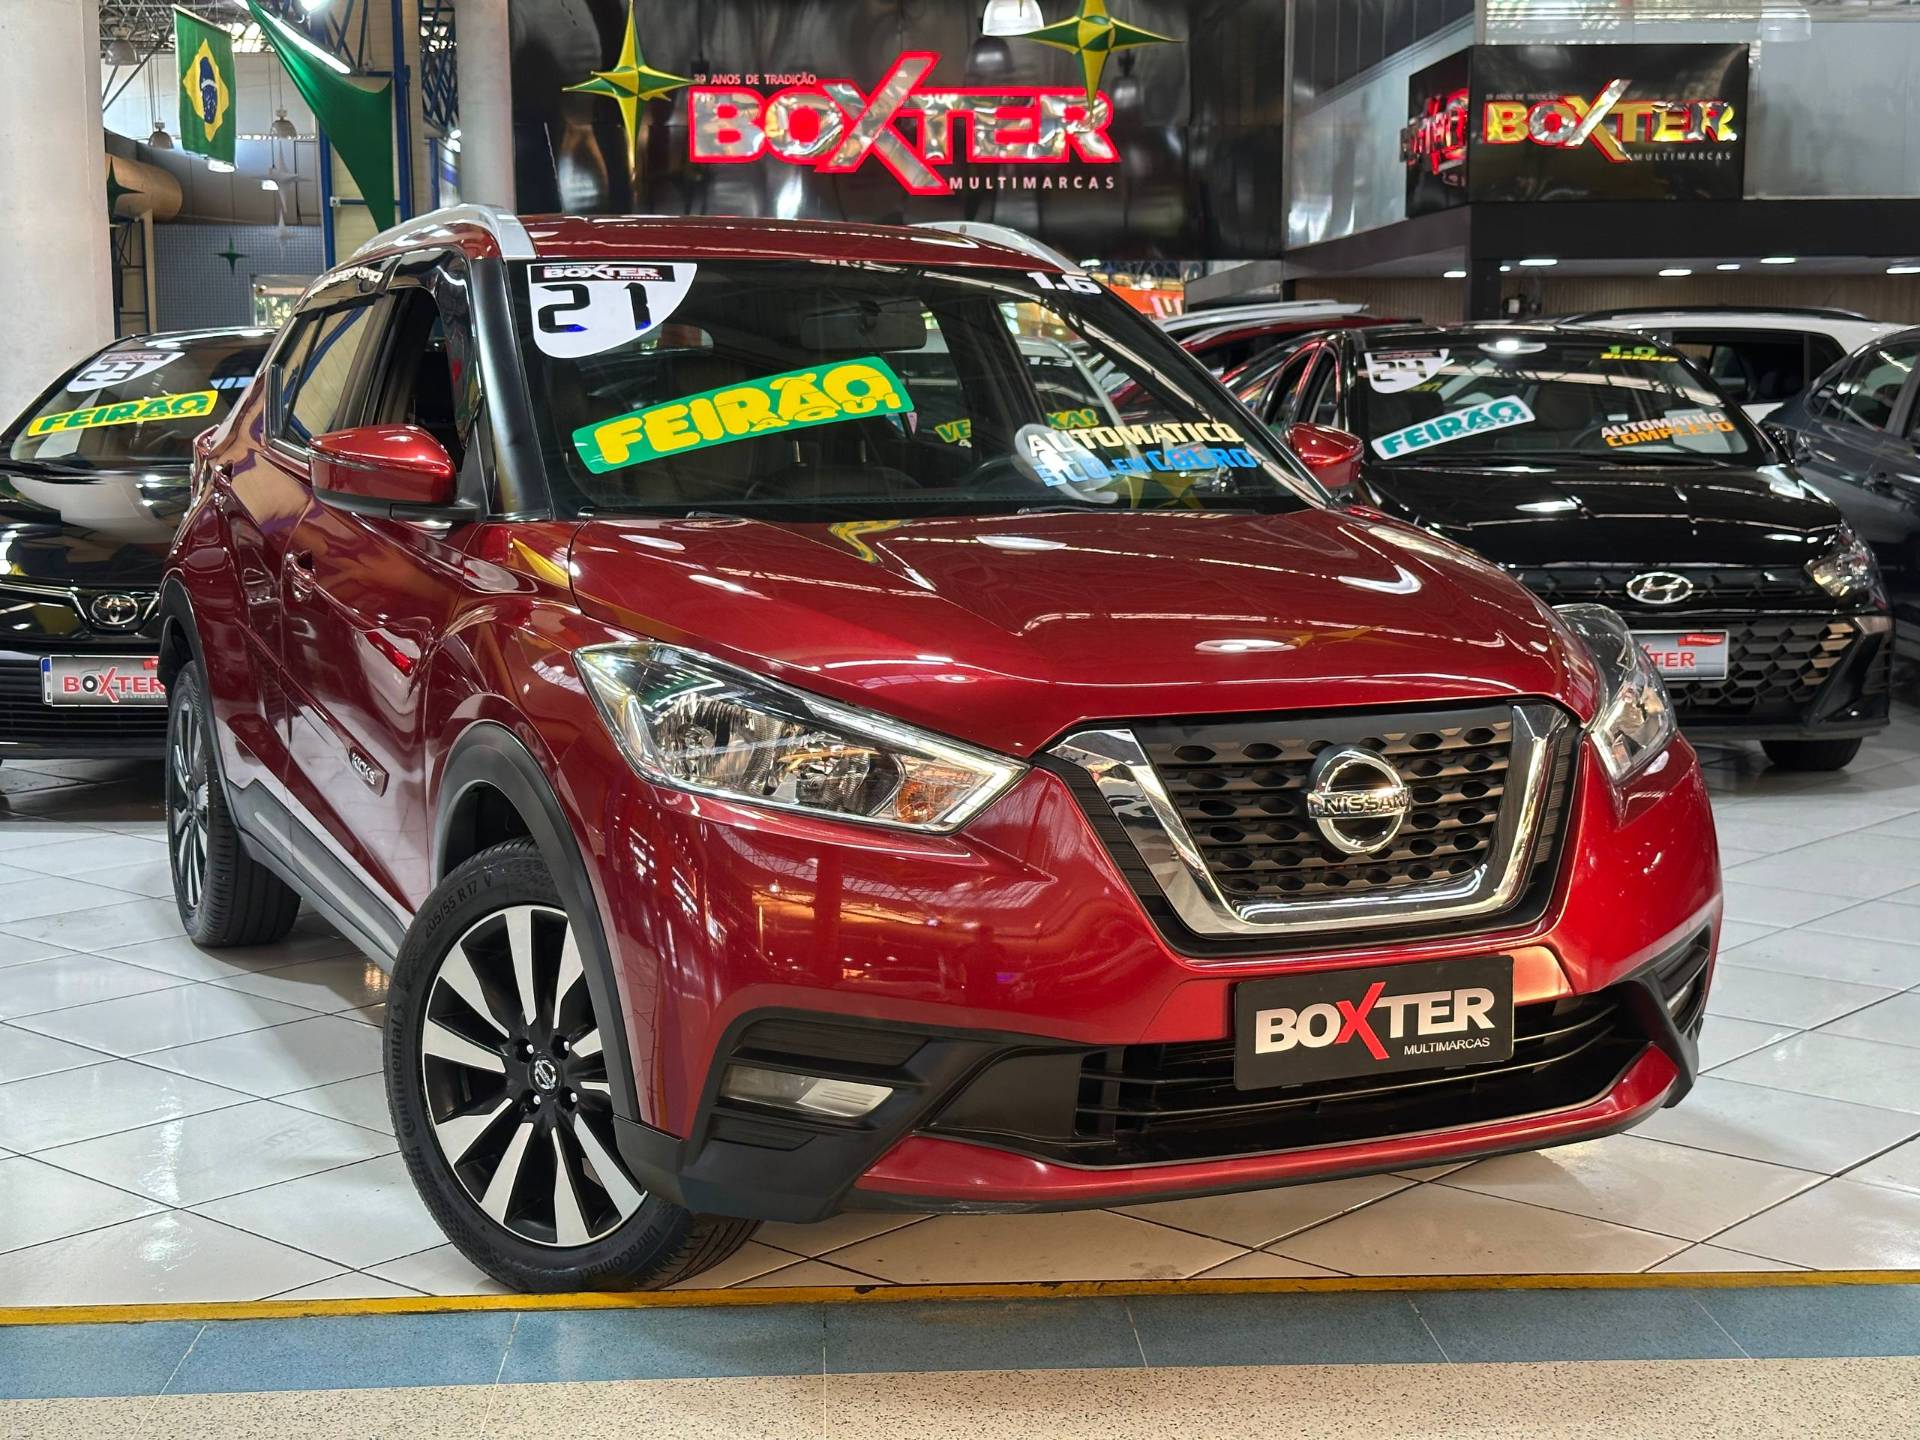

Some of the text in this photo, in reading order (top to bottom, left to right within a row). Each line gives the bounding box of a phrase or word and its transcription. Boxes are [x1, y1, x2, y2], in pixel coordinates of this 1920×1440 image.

[711, 74, 741, 85] ANOS
[746, 74, 759, 85] DE
[764, 71, 816, 87] TRADIÇÃO
[688, 51, 1120, 195] BOXTER
[1482, 79, 1737, 163] BOXTER
[1633, 151, 1732, 162] MULTIMARCAS
[950, 176, 1116, 190] MULTIMARCAS
[543, 264, 660, 280] BOXTER
[1026, 271, 1102, 294] 1.6
[538, 282, 652, 333] 21
[39, 395, 208, 431] FEIRÃO
[594, 364, 893, 464] FEIRÃO
[1381, 401, 1521, 454] FEIRÃO
[1322, 791, 1408, 814] NISSAN
[1255, 981, 1495, 1060] BOXTER
[1404, 1037, 1491, 1056] MULTIMARCAS
